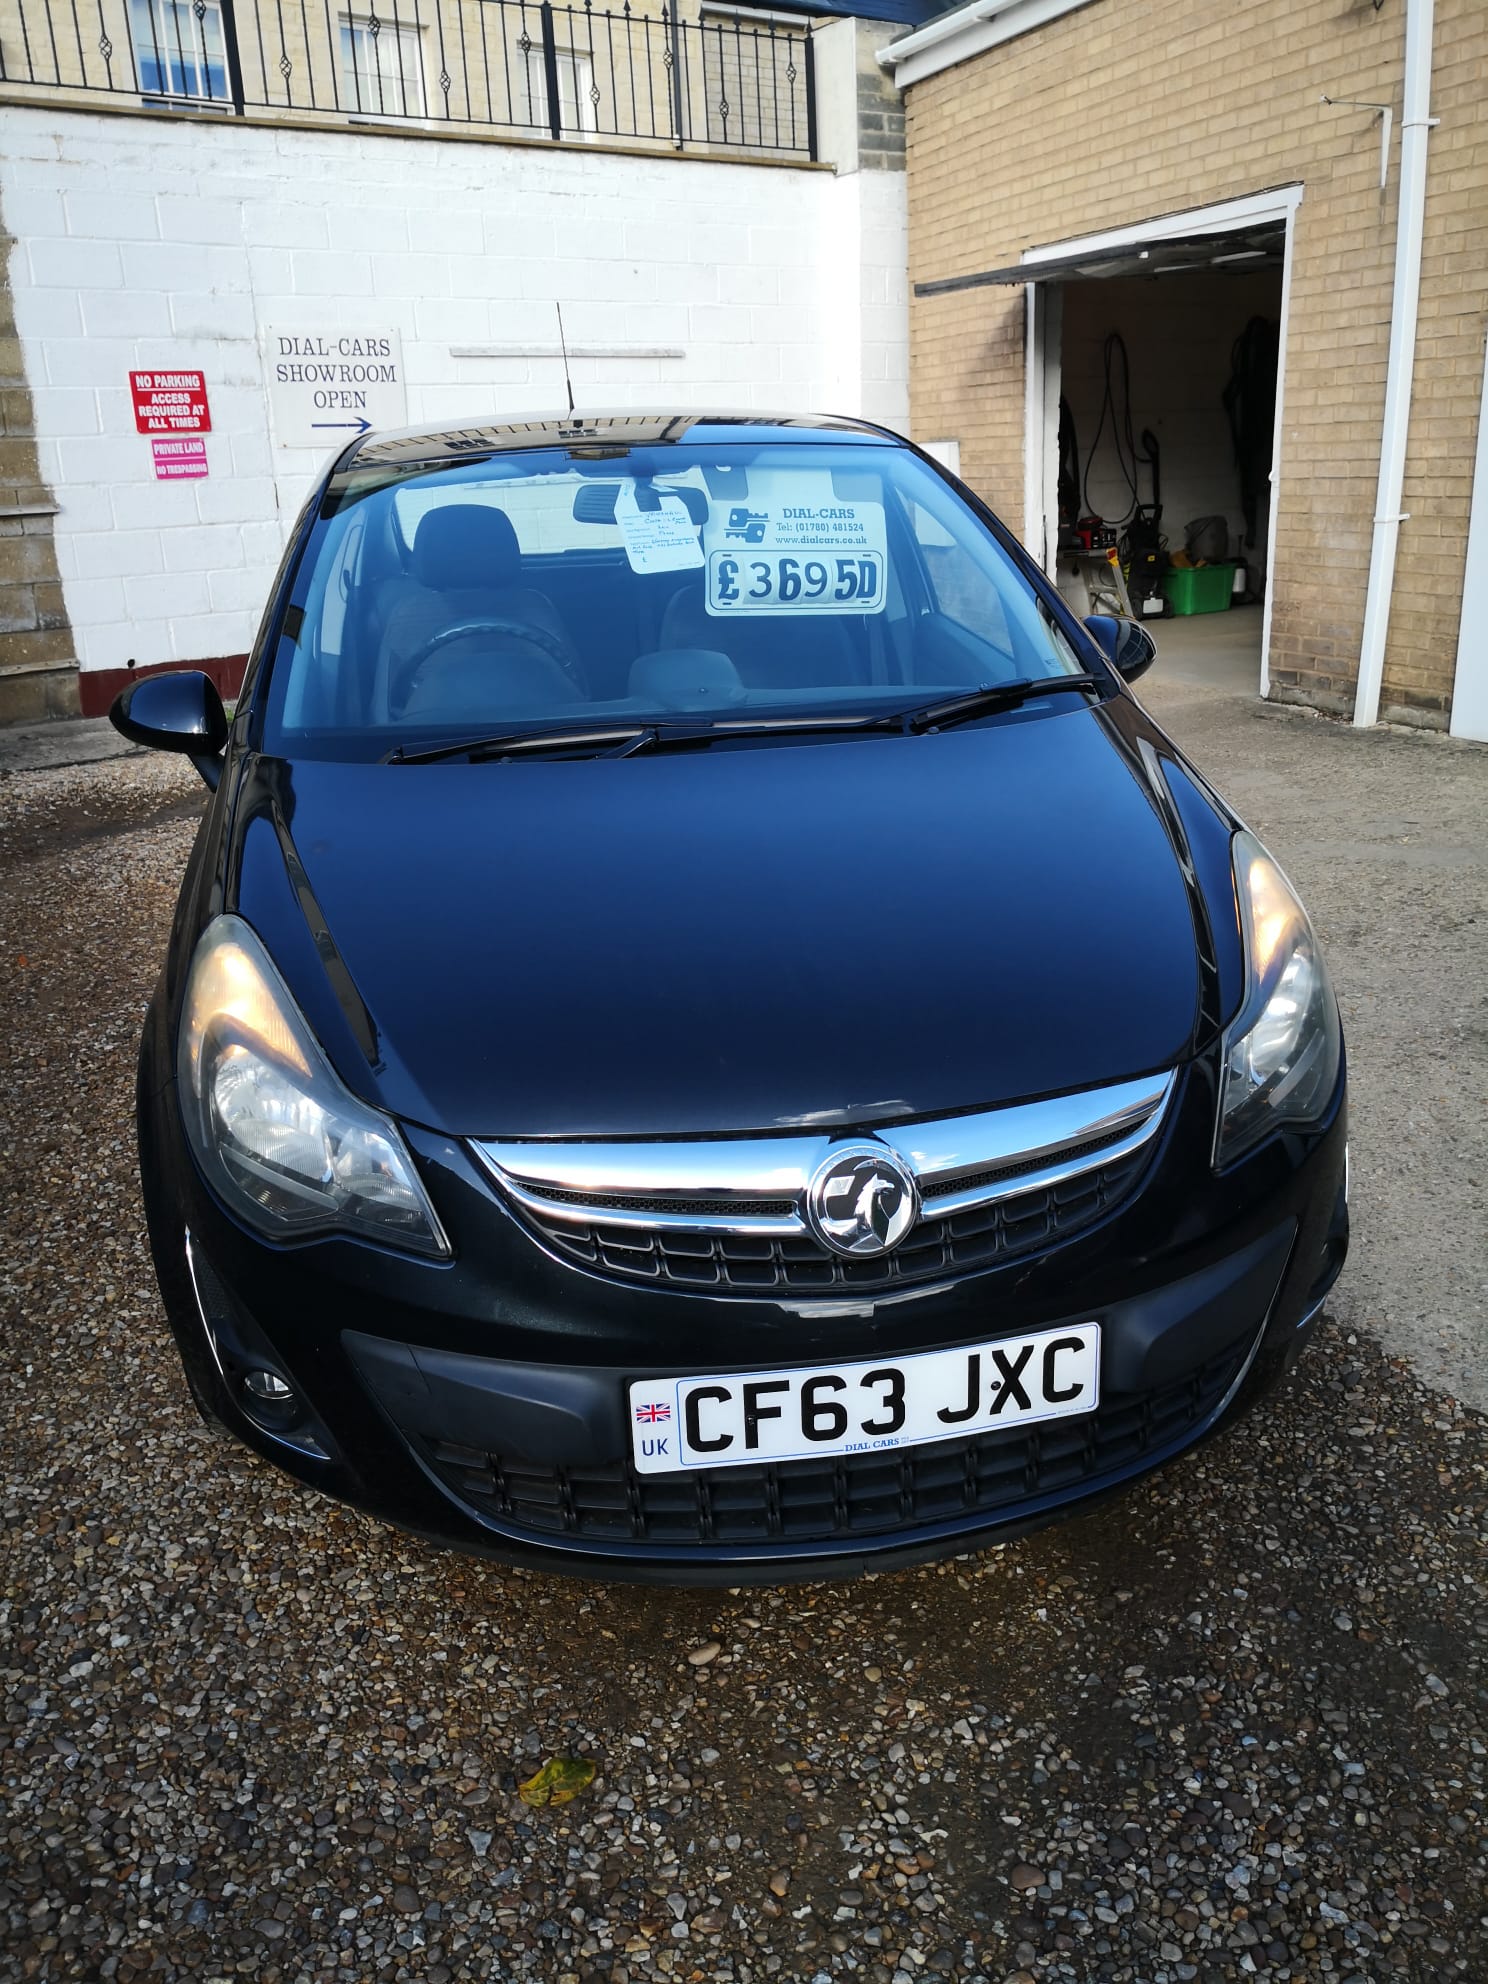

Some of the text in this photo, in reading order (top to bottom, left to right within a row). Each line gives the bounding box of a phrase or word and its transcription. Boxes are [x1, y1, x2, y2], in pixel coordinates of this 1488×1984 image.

[278, 337, 391, 356] DIAL-CARS
[276, 364, 397, 382] SHOWROOM
[135, 375, 200, 388] NO PARKING
[151, 393, 191, 404] ACCESS
[313, 390, 367, 408] OPEN
[138, 405, 205, 417] REQUIRED AT
[148, 417, 200, 429] ALL TIMES
[153, 442, 204, 455] PRIVATE LAND
[156, 465, 166, 475] NO
[782, 508, 855, 519] DIAL-CARS
[776, 522, 792, 531] Tel:
[796, 522, 829, 533] (01780)
[775, 535, 867, 544] www.dialcars.co.uk
[685, 1336, 1086, 1453] CF63 JXC
[641, 1438, 669, 1456] UK
[845, 1442, 870, 1451] DIAL
[873, 1438, 899, 1448] CARS
